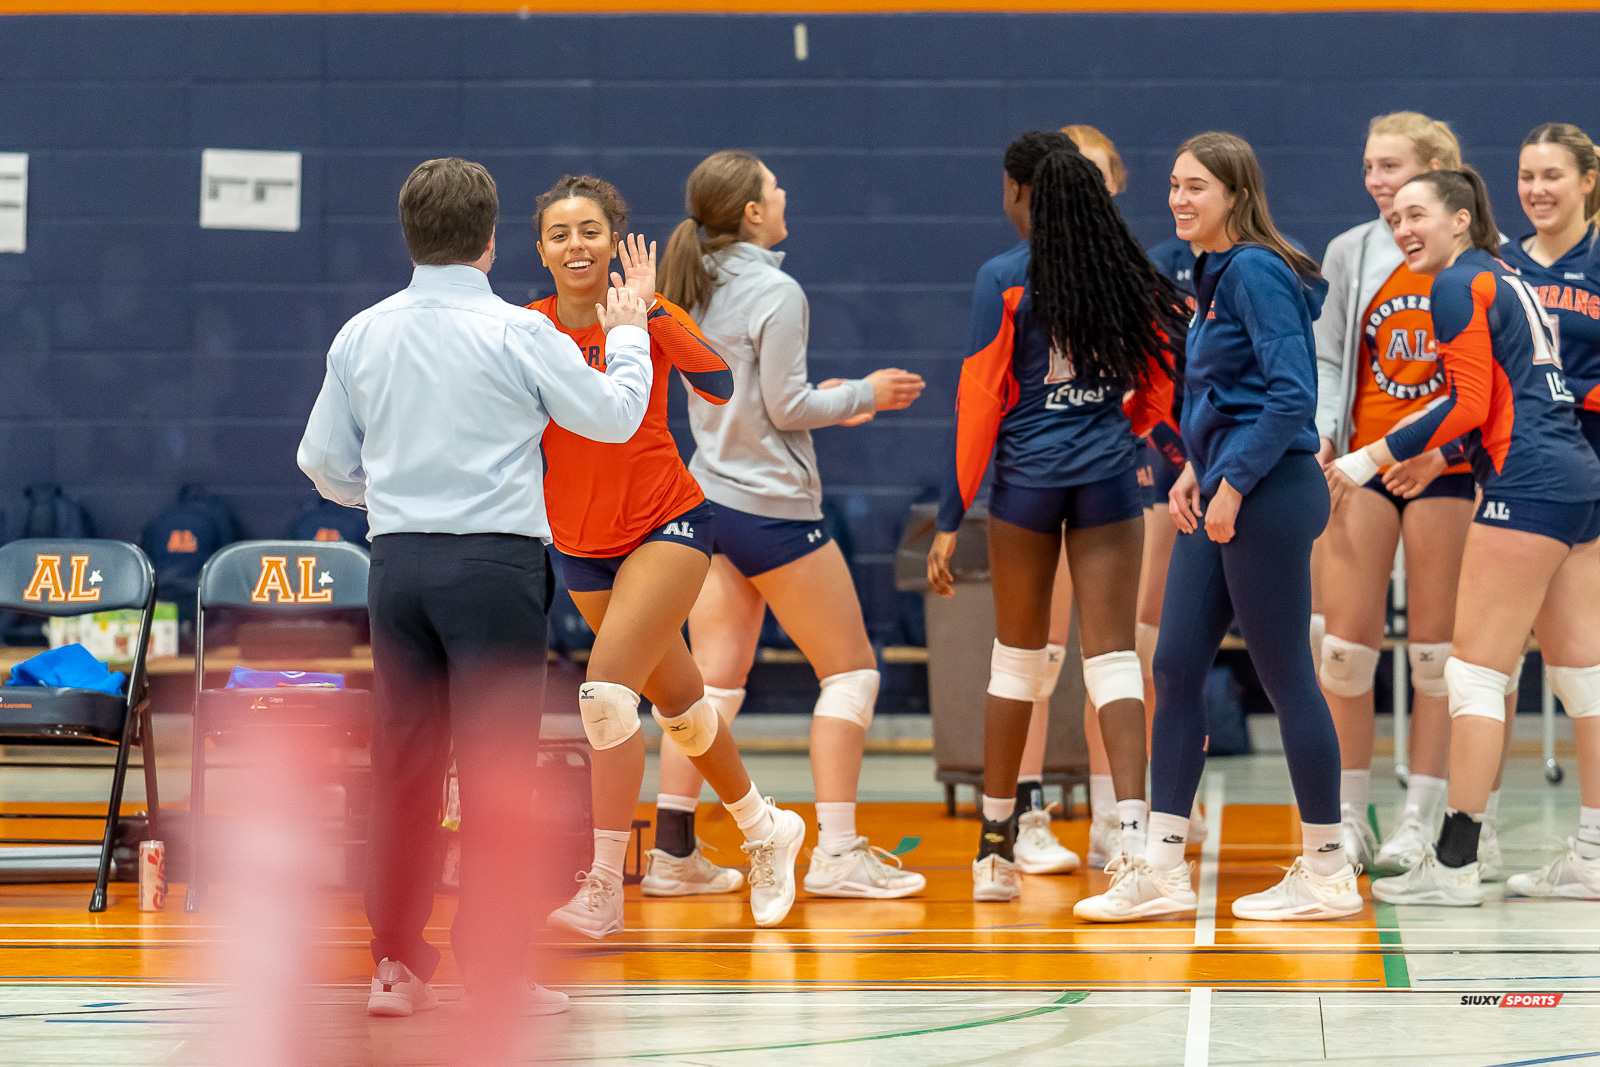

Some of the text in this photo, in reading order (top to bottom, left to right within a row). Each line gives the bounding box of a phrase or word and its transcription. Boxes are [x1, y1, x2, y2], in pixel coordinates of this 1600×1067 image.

[1534, 284, 1600, 320] ERANG
[1385, 328, 1437, 362] AL
[1482, 501, 1510, 521] AL
[663, 521, 694, 539] AL
[23, 554, 101, 602] AL
[251, 555, 333, 603] AL
